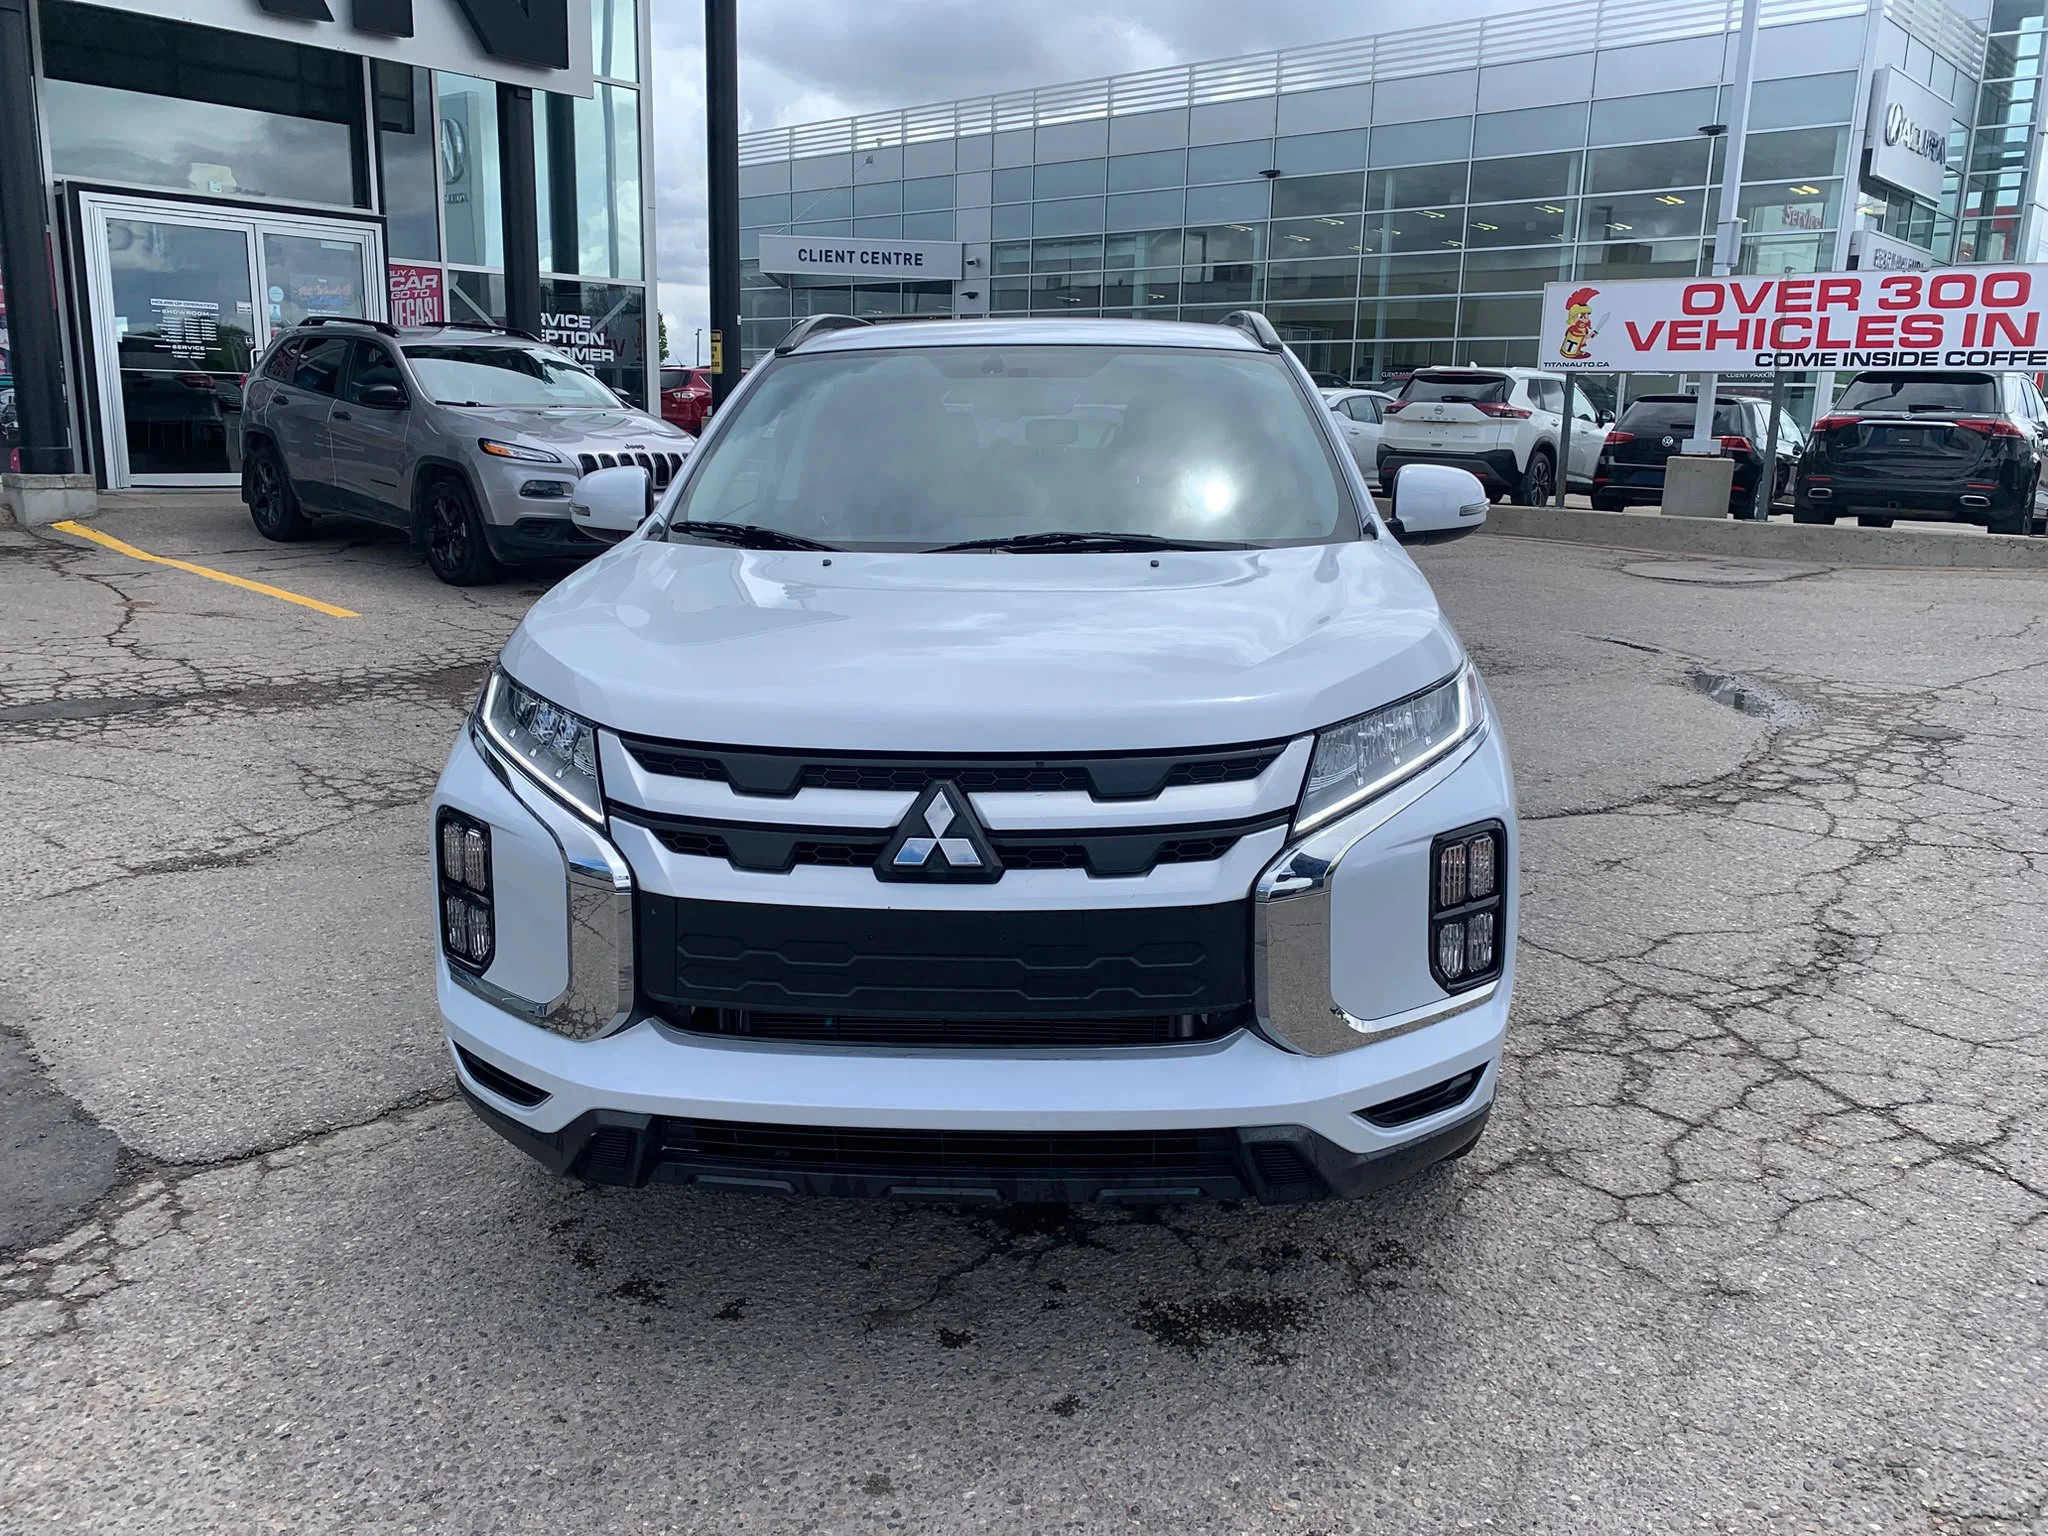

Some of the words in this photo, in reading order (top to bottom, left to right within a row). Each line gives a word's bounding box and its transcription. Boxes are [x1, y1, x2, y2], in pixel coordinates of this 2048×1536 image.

[798, 248, 856, 264] CLIENT
[860, 251, 924, 267] CENTRE
[390, 274, 438, 292] CAR
[391, 290, 410, 300] GO
[412, 289, 430, 298] TO
[1682, 278, 1862, 315] OVER
[1878, 272, 2032, 310] 300
[161, 309, 210, 317] SHOWROOM
[1624, 314, 1945, 351] VEHICLES
[1961, 311, 2040, 348] IN
[1754, 351, 1837, 367] COME
[1842, 351, 1940, 367] INSIDE
[1945, 350, 2048, 366] COFFE
